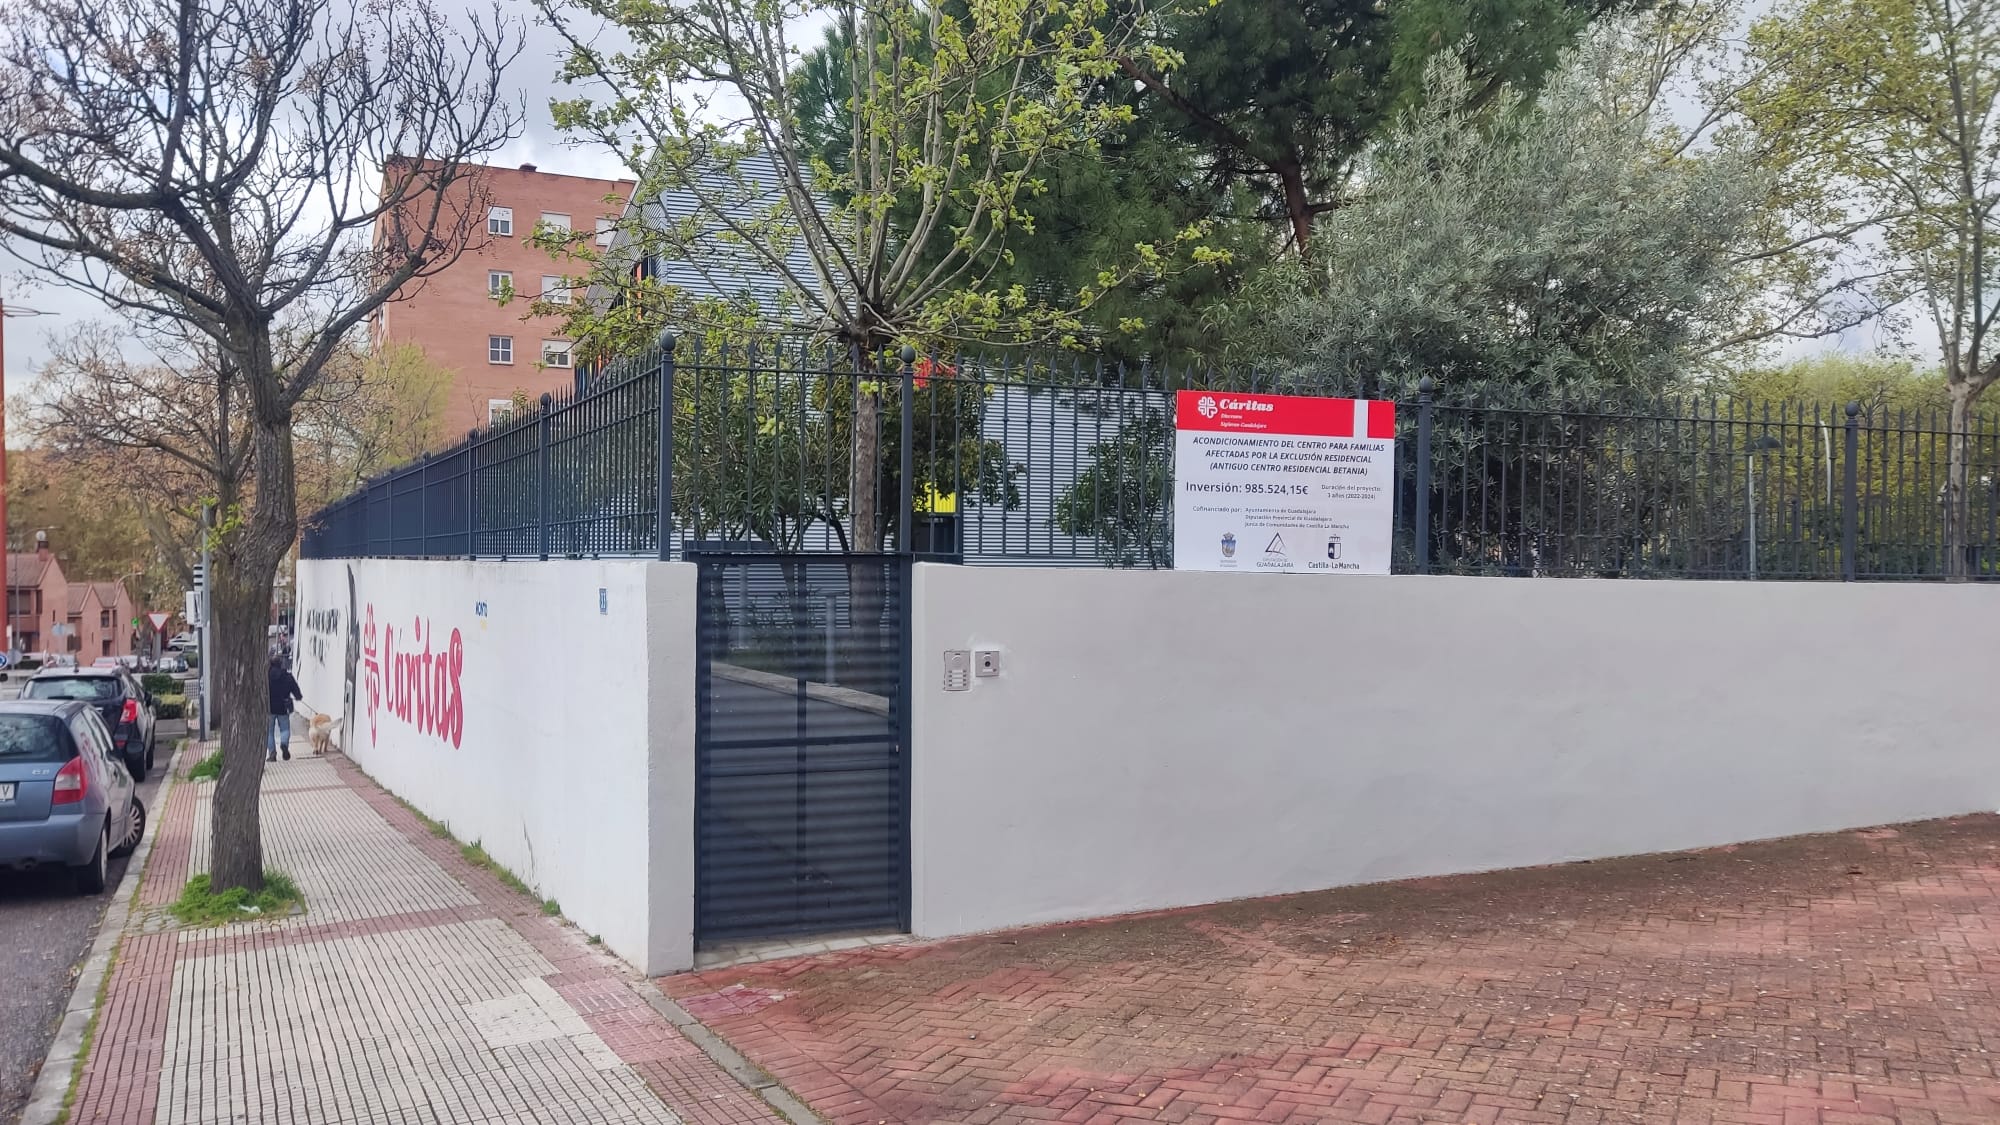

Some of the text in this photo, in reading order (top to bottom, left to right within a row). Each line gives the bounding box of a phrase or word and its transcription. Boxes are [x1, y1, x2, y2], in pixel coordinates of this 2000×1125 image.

[1219, 398, 1274, 412] Cáritas
[1192, 437, 1385, 452] ACONDICIONAMIENTO DEL CENTRO PARA FAMILIAS
[1206, 450, 1372, 464] AFECTADAS POR LA EXCLUSIÓN RESIDENCIAL
[1210, 462, 1368, 476] (ANTIGUO CENTRO RESIDENCIAL BETANIA)
[1186, 482, 1309, 496] Inversión: 985.524,15€
[384, 615, 463, 750] Cáritas
